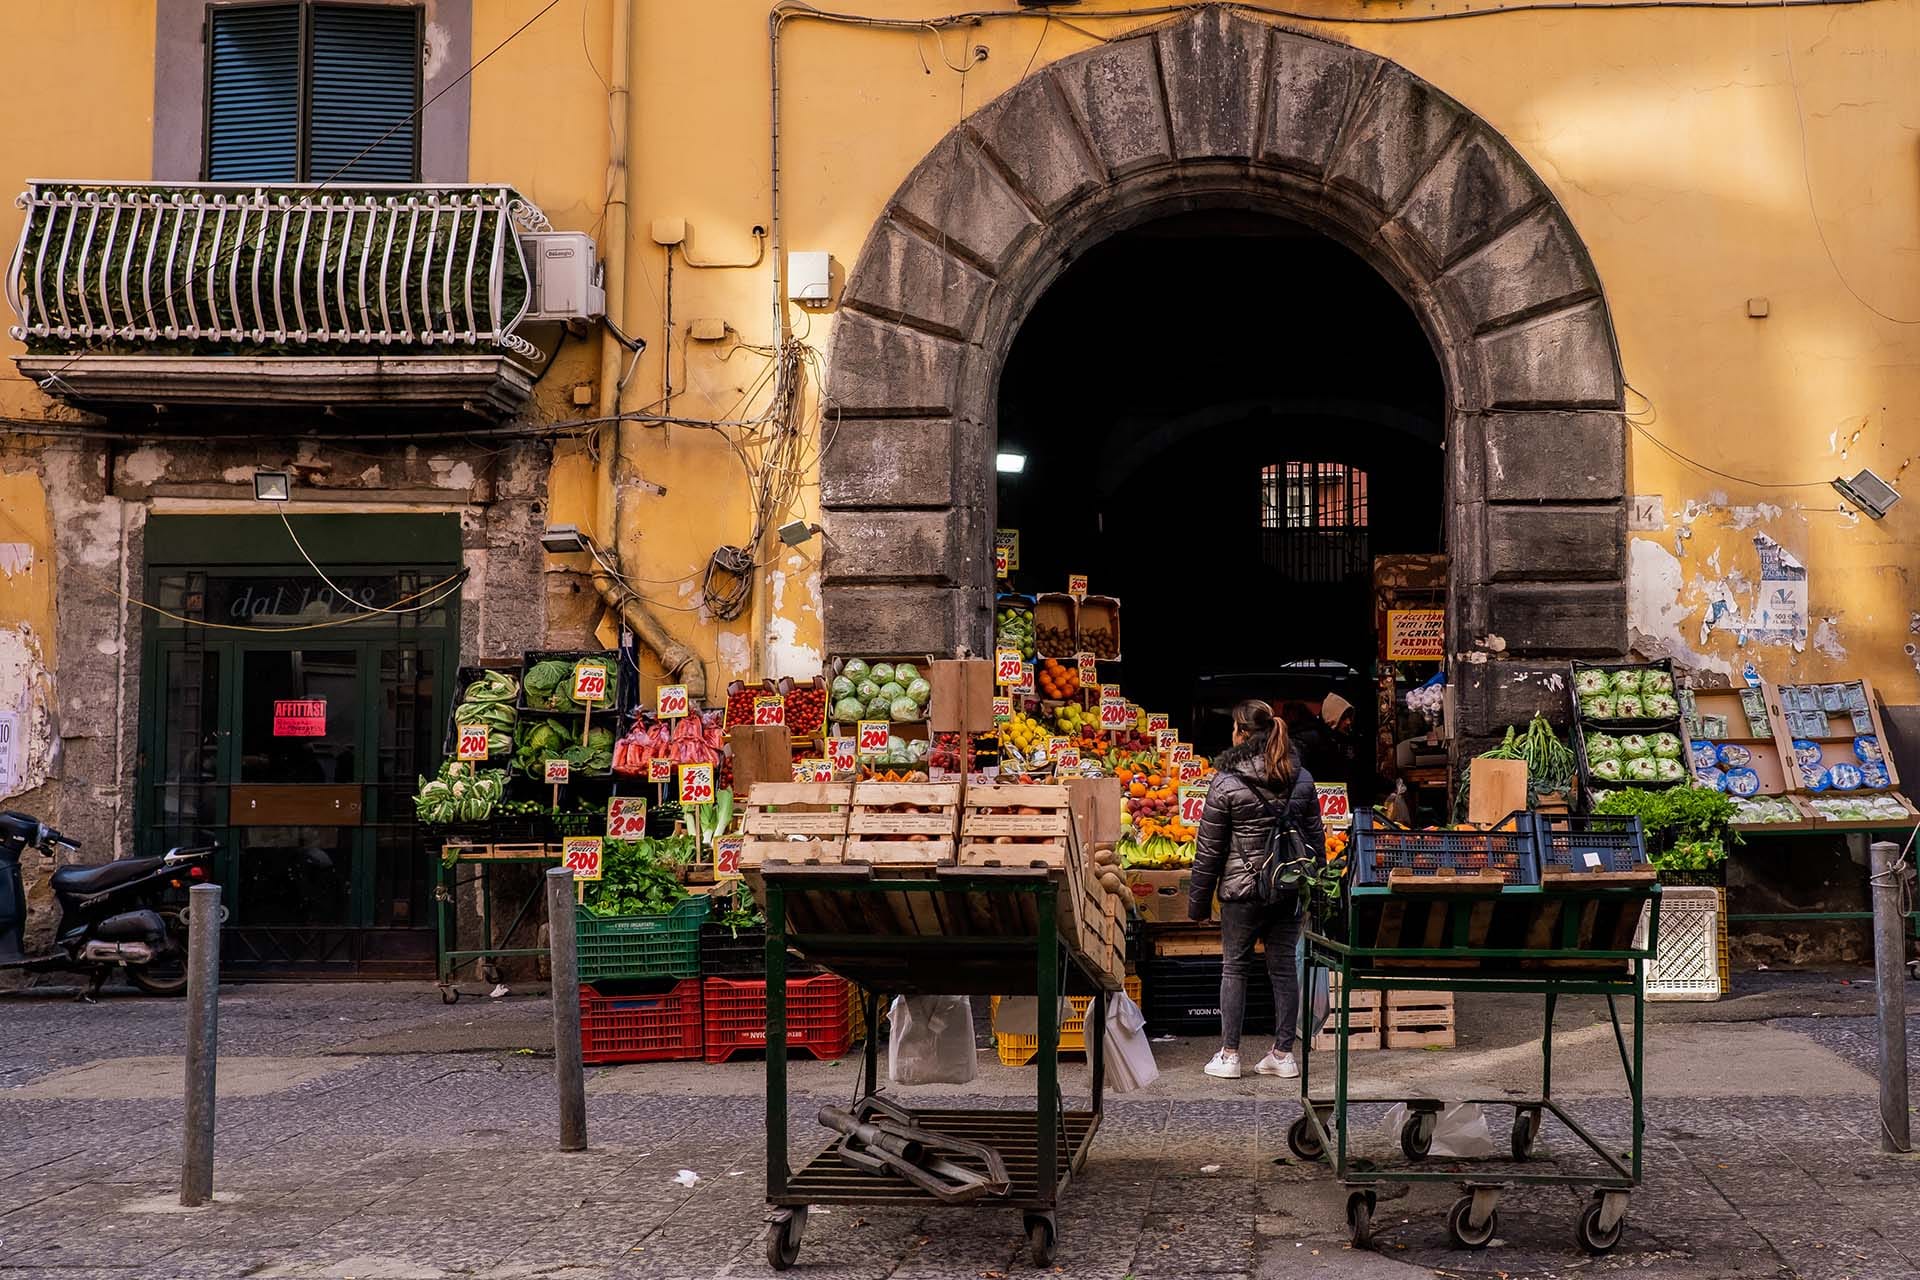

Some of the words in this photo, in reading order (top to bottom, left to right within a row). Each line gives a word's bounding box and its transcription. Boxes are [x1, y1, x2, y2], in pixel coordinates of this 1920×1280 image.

[1635, 504, 1654, 522] 14
[230, 586, 284, 618] dal
[275, 702, 325, 717] AFFITTASI
[828, 741, 839, 756] 3
[611, 799, 624, 818] 5
